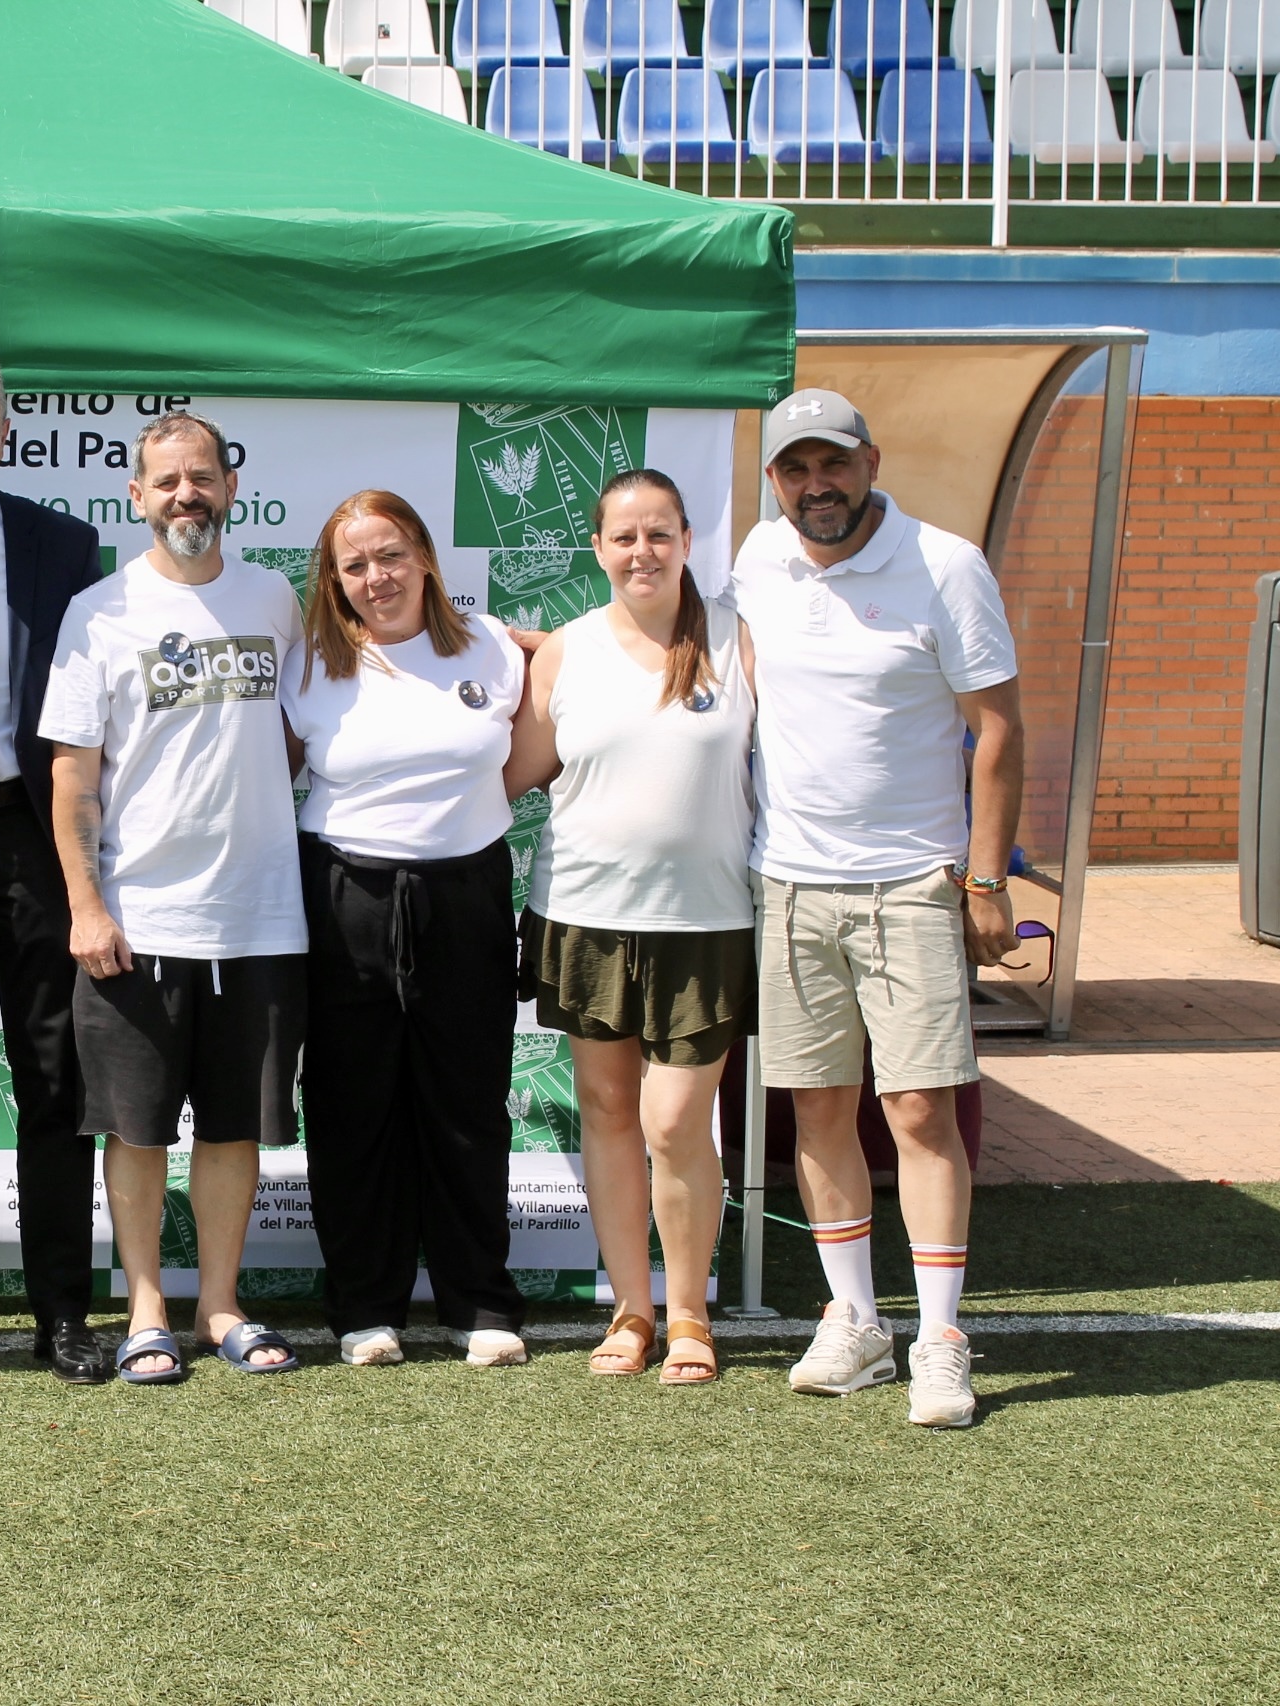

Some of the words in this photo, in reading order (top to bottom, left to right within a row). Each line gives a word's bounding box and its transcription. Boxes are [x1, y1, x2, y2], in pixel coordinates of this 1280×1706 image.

[87, 491, 287, 534] mupio
[571, 511, 588, 535] AVE
[150, 644, 275, 688] adidas
[154, 682, 275, 703] SPORTSWEAR
[253, 1199, 270, 1211] de
[273, 1199, 312, 1211] Villan
[517, 1201, 588, 1213] Villanueva
[260, 1217, 281, 1229] del
[509, 1218, 523, 1230] el
[527, 1218, 580, 1230] Pardillo
